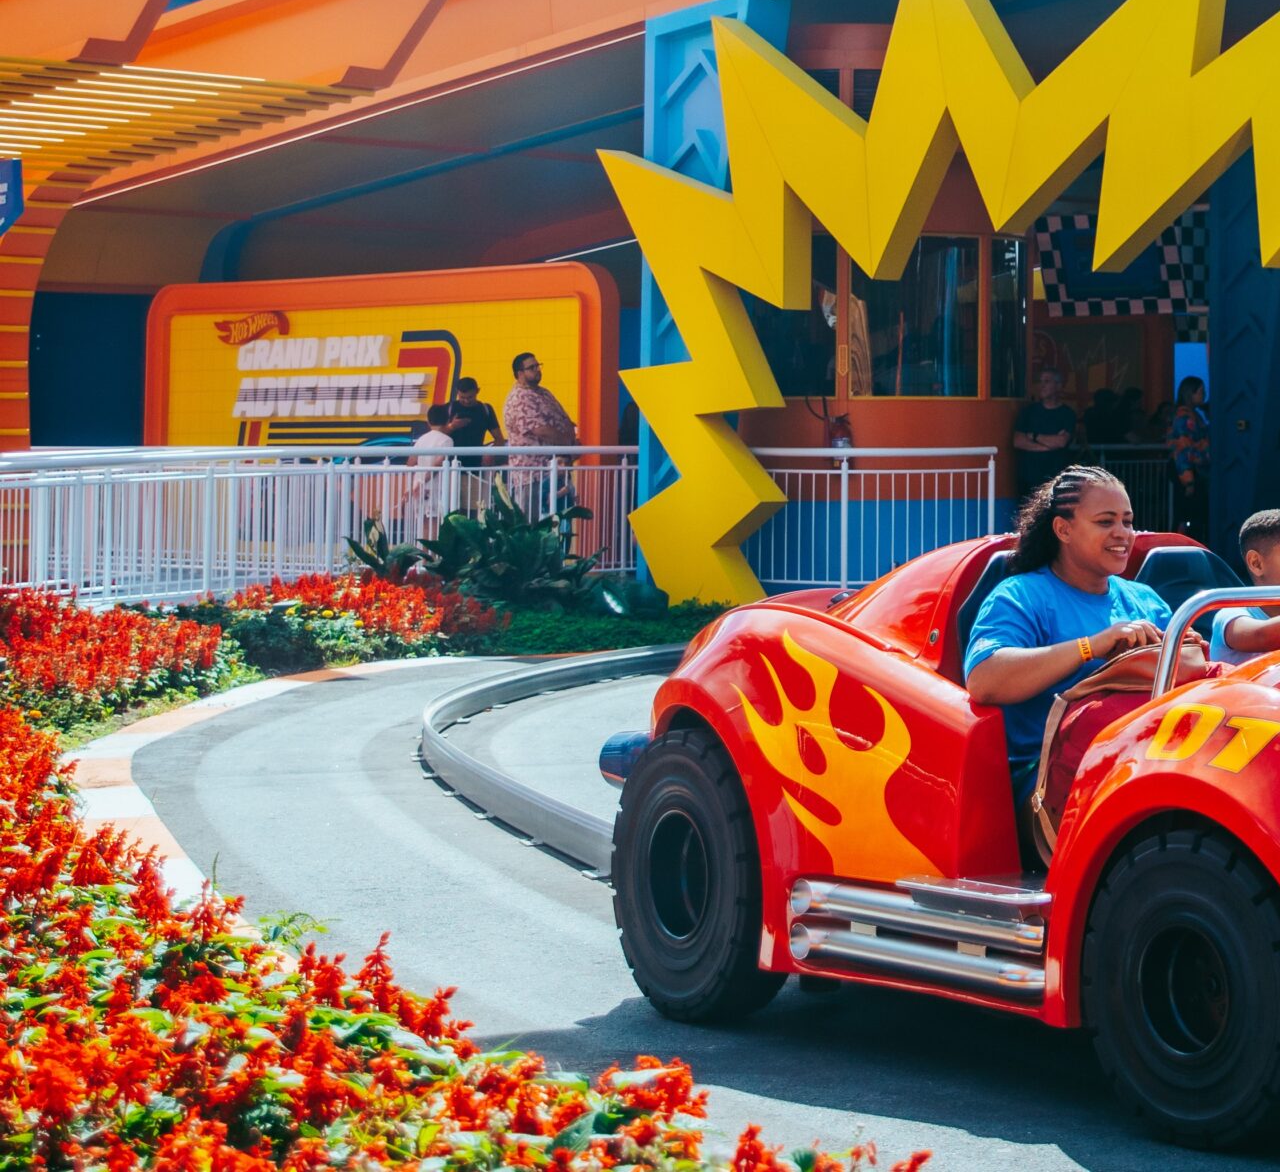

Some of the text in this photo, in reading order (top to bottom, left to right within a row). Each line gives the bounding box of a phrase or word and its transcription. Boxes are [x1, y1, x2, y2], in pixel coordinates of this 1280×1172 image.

[229, 321, 248, 343] HOT
[237, 335, 387, 371] GRAND PRIX
[232, 373, 428, 418] ADVENTURE
